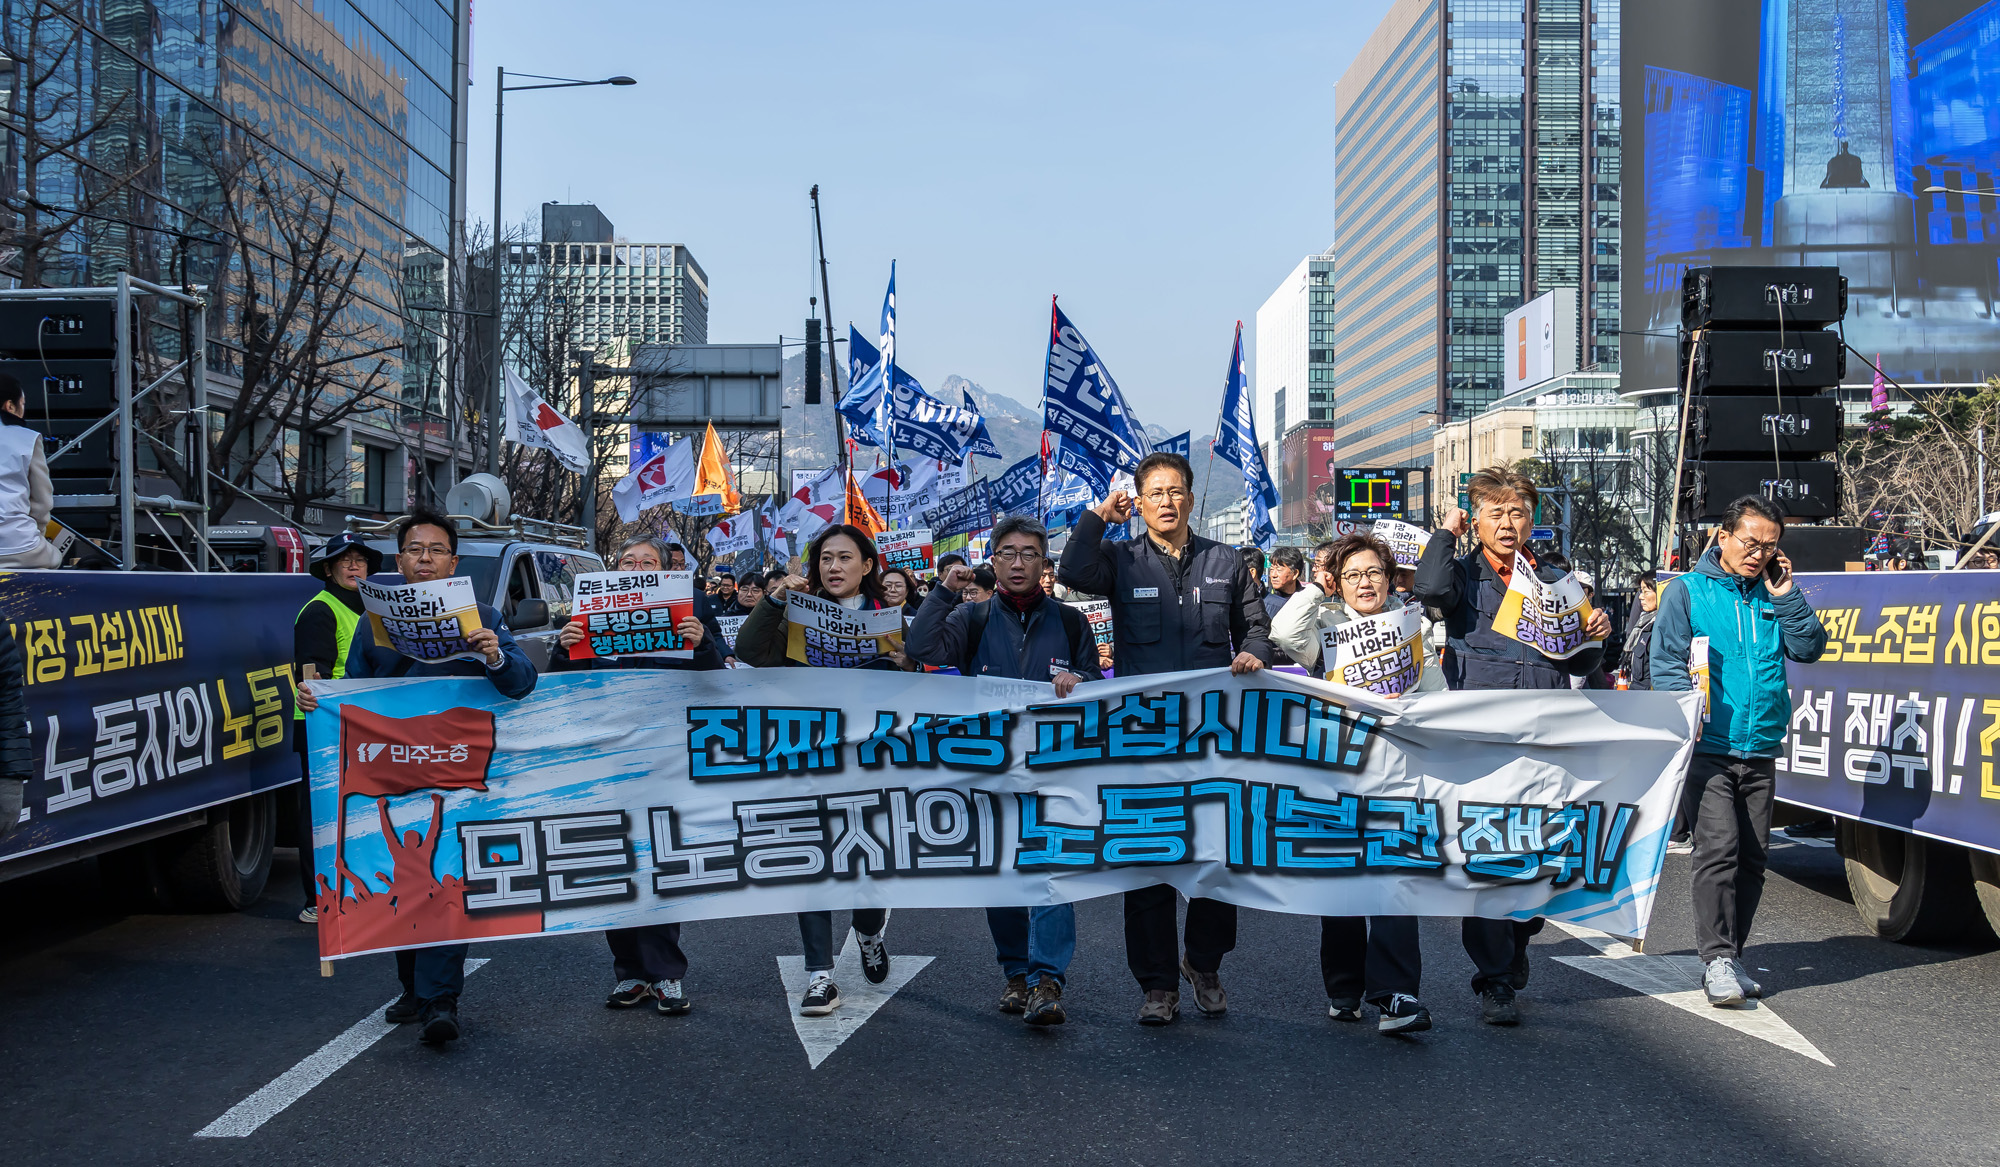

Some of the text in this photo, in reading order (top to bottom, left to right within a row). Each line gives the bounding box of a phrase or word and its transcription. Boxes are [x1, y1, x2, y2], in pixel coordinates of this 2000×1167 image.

[1557, 392, 1616, 405] 일민미술관
[877, 536, 890, 544] 모든
[890, 531, 915, 541] 노동자의
[880, 540, 908, 552] 노동기본권
[1387, 540, 1419, 555] 청교섭
[885, 547, 922, 563] 투쟁으로
[360, 582, 416, 603] 진짜사장
[577, 573, 659, 596] 모든 노동자의
[390, 596, 446, 618] 나와라!
[579, 592, 644, 612] 노동기본권
[790, 593, 843, 620] 진짜사장
[381, 615, 461, 640] 원청교섭
[588, 606, 671, 635] 투쟁으로
[817, 616, 867, 636] 나와라!
[69, 604, 183, 677] 교섭시대!
[591, 630, 684, 656] 쟁취하자!
[804, 627, 878, 654] 원청교섭
[1324, 620, 1377, 648] 진짜사장
[1352, 626, 1404, 658] 나와라!
[1816, 604, 1941, 664] 정노조법
[1343, 644, 1412, 686] 원청교섭
[1361, 661, 1420, 696] 취하자!
[687, 689, 1378, 780] 진짜 사장 교섭시대!
[1775, 689, 1834, 777] 섭
[1843, 690, 1976, 795] 쟁취!
[44, 682, 214, 814] 노동자의
[391, 742, 469, 763] 민주노총
[457, 778, 1639, 914] 모든 노동자의 노동기본권 쟁취!
